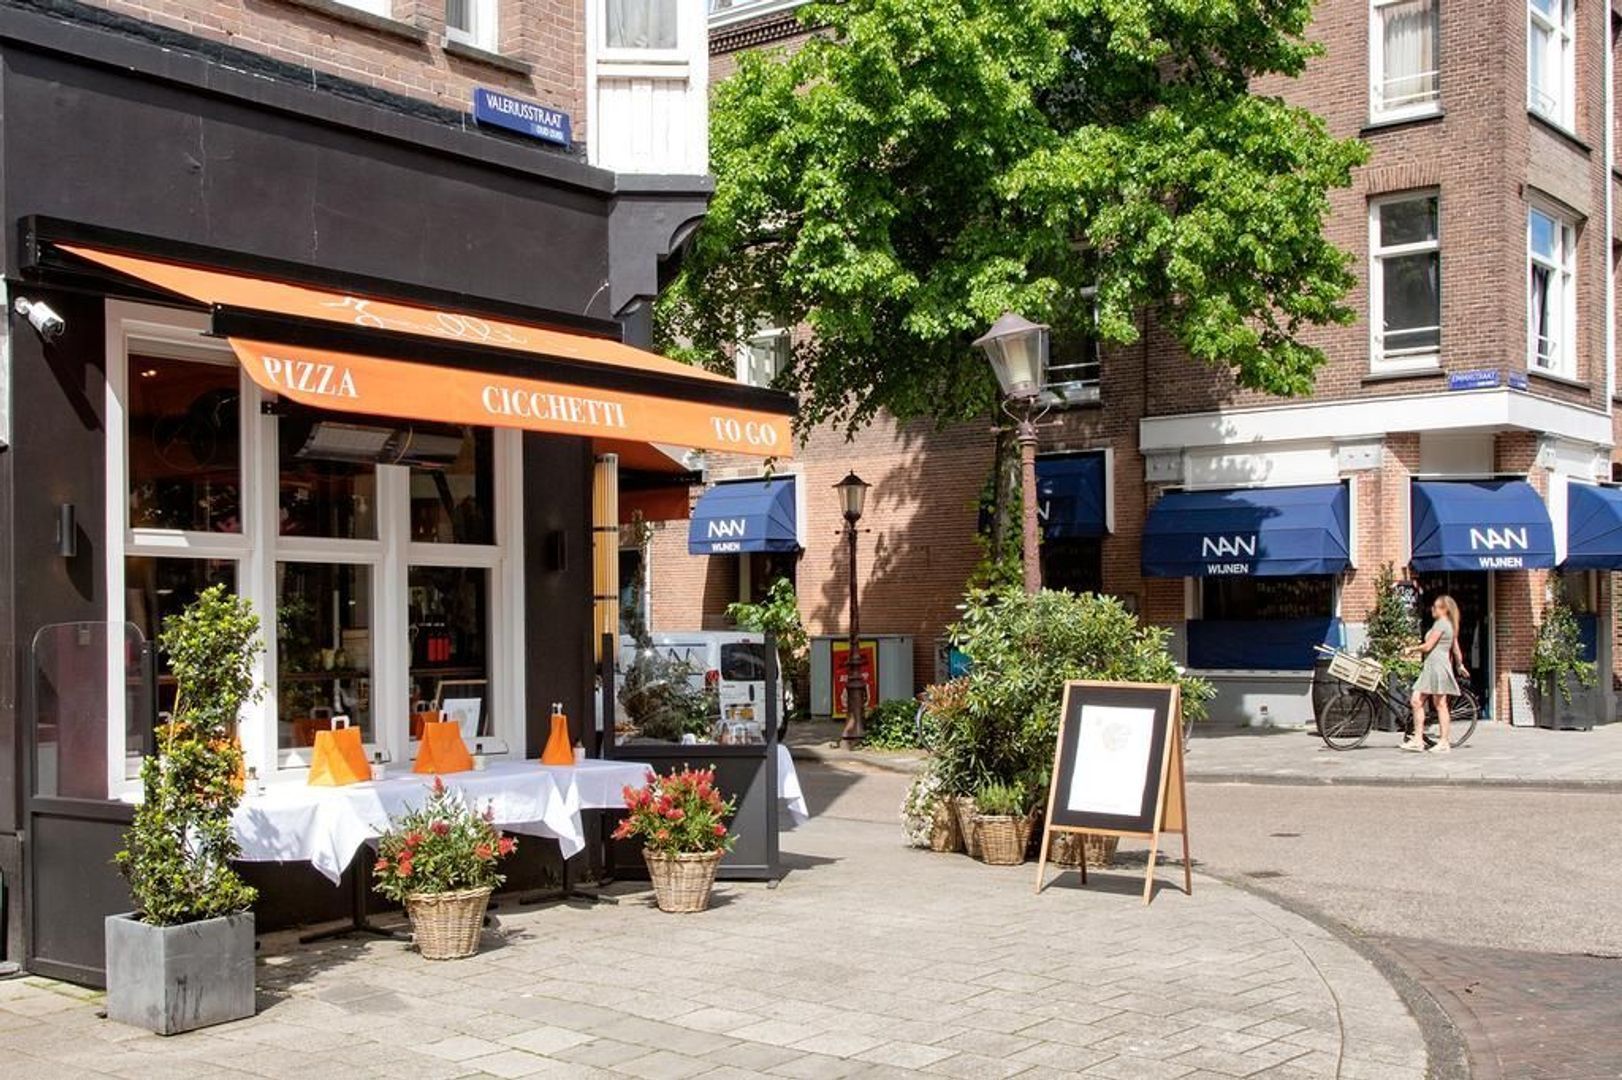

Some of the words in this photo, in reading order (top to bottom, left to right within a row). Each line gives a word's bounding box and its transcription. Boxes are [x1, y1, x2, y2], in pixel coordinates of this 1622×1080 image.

[486, 93, 562, 128] VALERIUSSTRAAT
[263, 357, 358, 398] PIZZA
[482, 385, 626, 428] CICCHETTI
[711, 416, 740, 442] TO
[746, 421, 777, 446] GO
[707, 519, 746, 538] NAN
[1470, 528, 1528, 549] NAN
[1202, 535, 1256, 557] NAN
[1207, 564, 1249, 574] WIJNEN
[1479, 557, 1523, 568] WIJNEN
